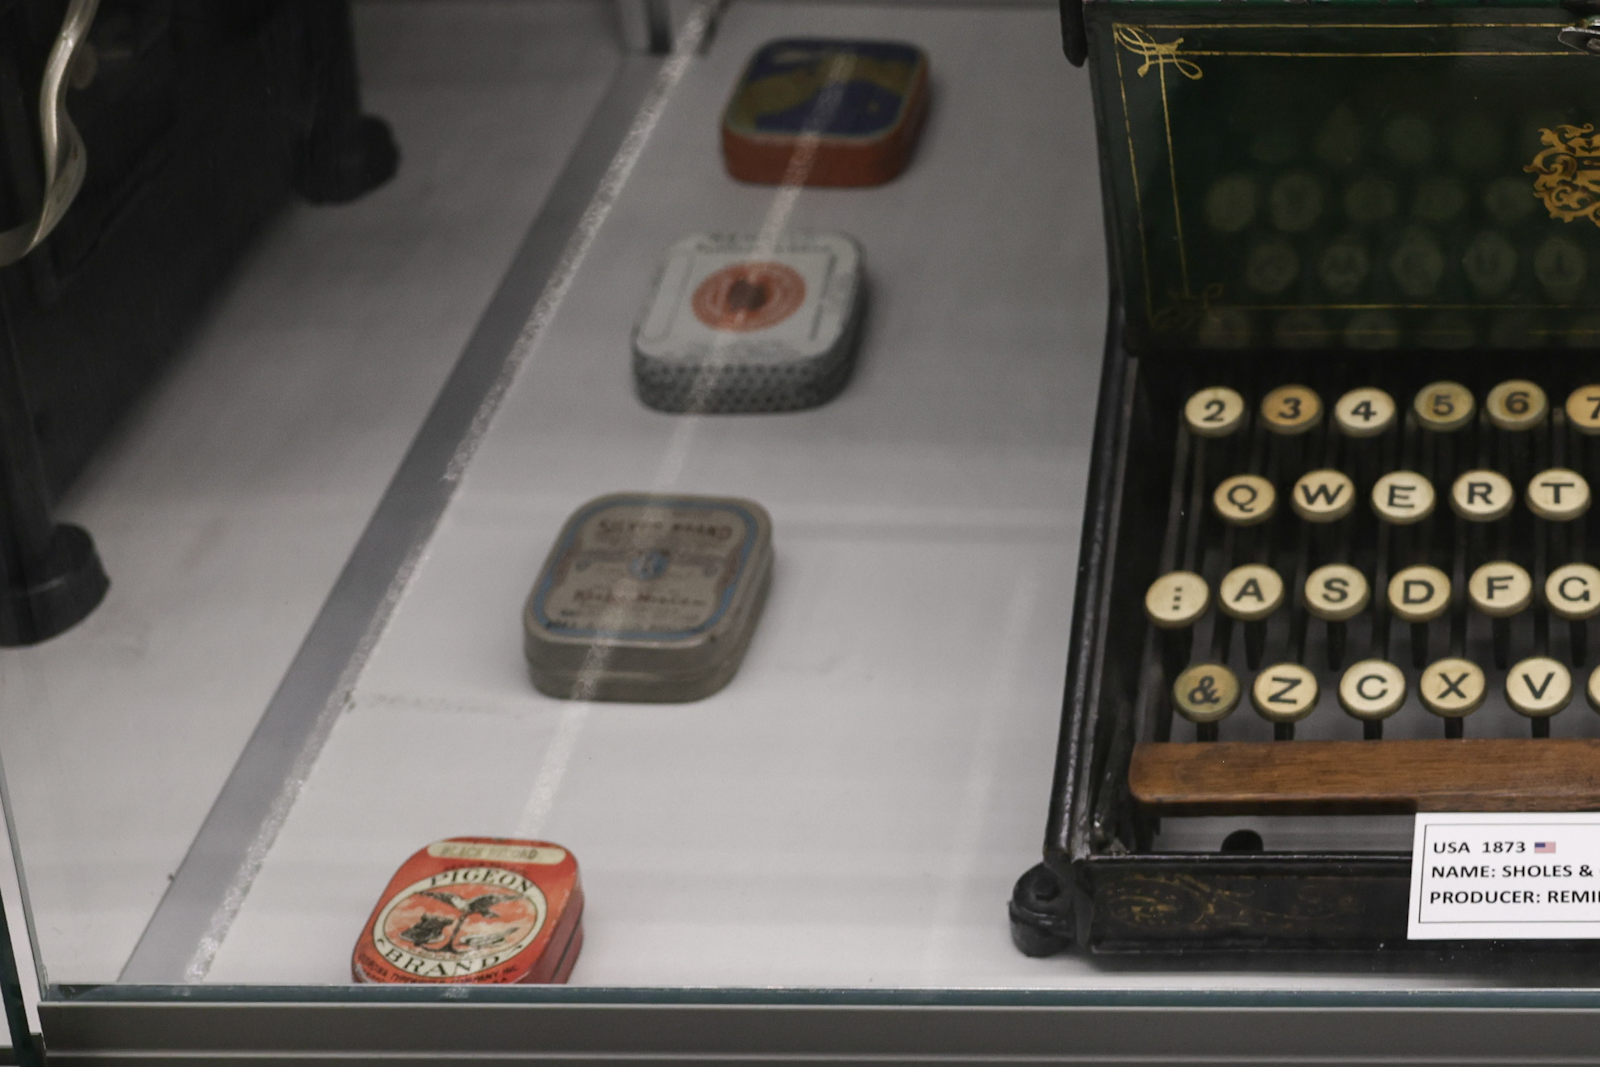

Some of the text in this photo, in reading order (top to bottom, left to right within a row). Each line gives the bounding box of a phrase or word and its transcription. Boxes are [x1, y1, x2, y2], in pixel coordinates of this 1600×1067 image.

[1202, 398, 1227, 423] 2
[1278, 397, 1302, 420] 3
[1350, 400, 1377, 422] 4
[1432, 394, 1455, 417] 5
[1503, 390, 1531, 416] 6
[1226, 483, 1259, 514] Q
[1299, 483, 1345, 507] W
[1386, 483, 1417, 510] E
[1466, 481, 1494, 506] R
[1539, 481, 1576, 506] T
[1232, 577, 1266, 603] A
[1321, 576, 1351, 605] S
[1401, 578, 1436, 606] D
[1485, 574, 1515, 601] F
[1557, 575, 1591, 603] G
[1186, 674, 1222, 707] &
[1266, 675, 1303, 706] Z
[1355, 673, 1389, 702] C
[1436, 671, 1471, 700] X
[1521, 671, 1556, 701] V
[1432, 841, 1527, 854] USA 1873
[430, 867, 536, 894] PIGEON
[1430, 865, 1496, 879] NAME:
[1501, 864, 1574, 879] SHOLES
[1577, 864, 1594, 878] &
[1429, 890, 1541, 905] PRODUCER:
[384, 946, 501, 976] BRAND
